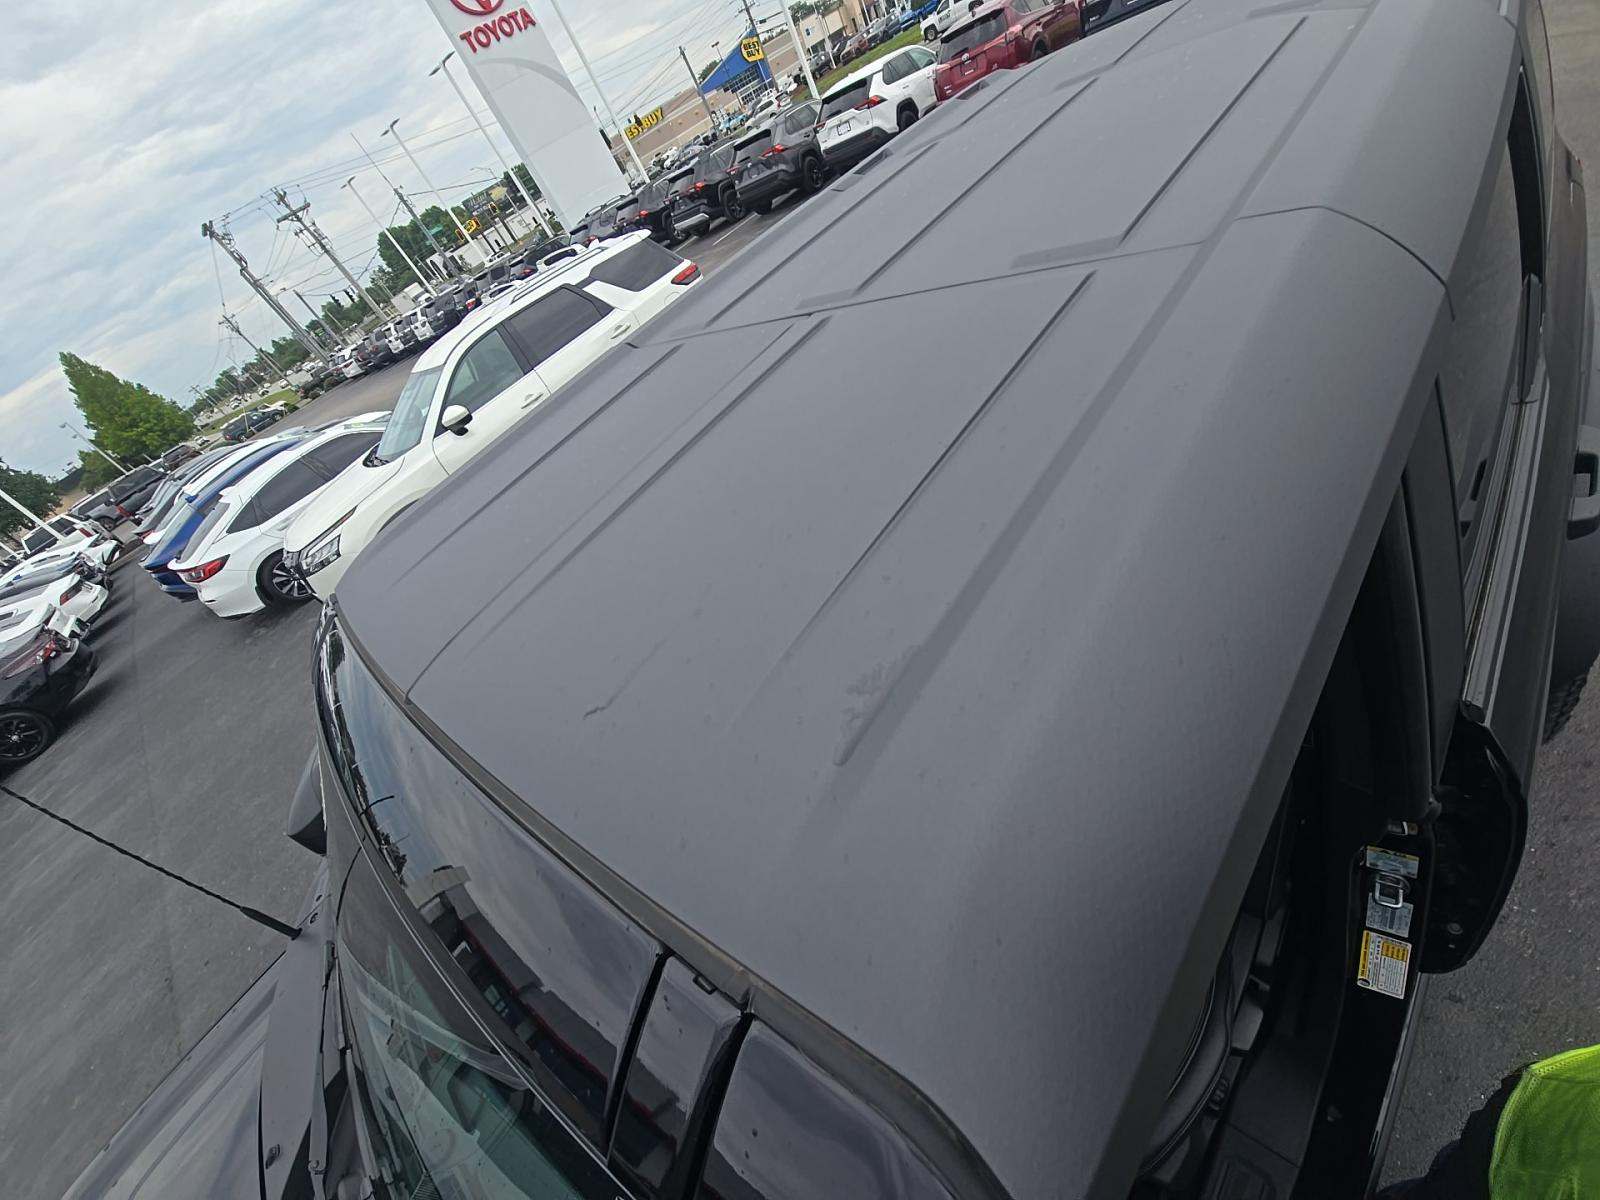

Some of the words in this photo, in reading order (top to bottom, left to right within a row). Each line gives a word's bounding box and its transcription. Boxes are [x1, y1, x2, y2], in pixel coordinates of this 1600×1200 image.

[459, 7, 536, 53] TOYOTA
[743, 40, 760, 51] BEST
[745, 48, 761, 58] BUY
[641, 105, 664, 129] BUY
